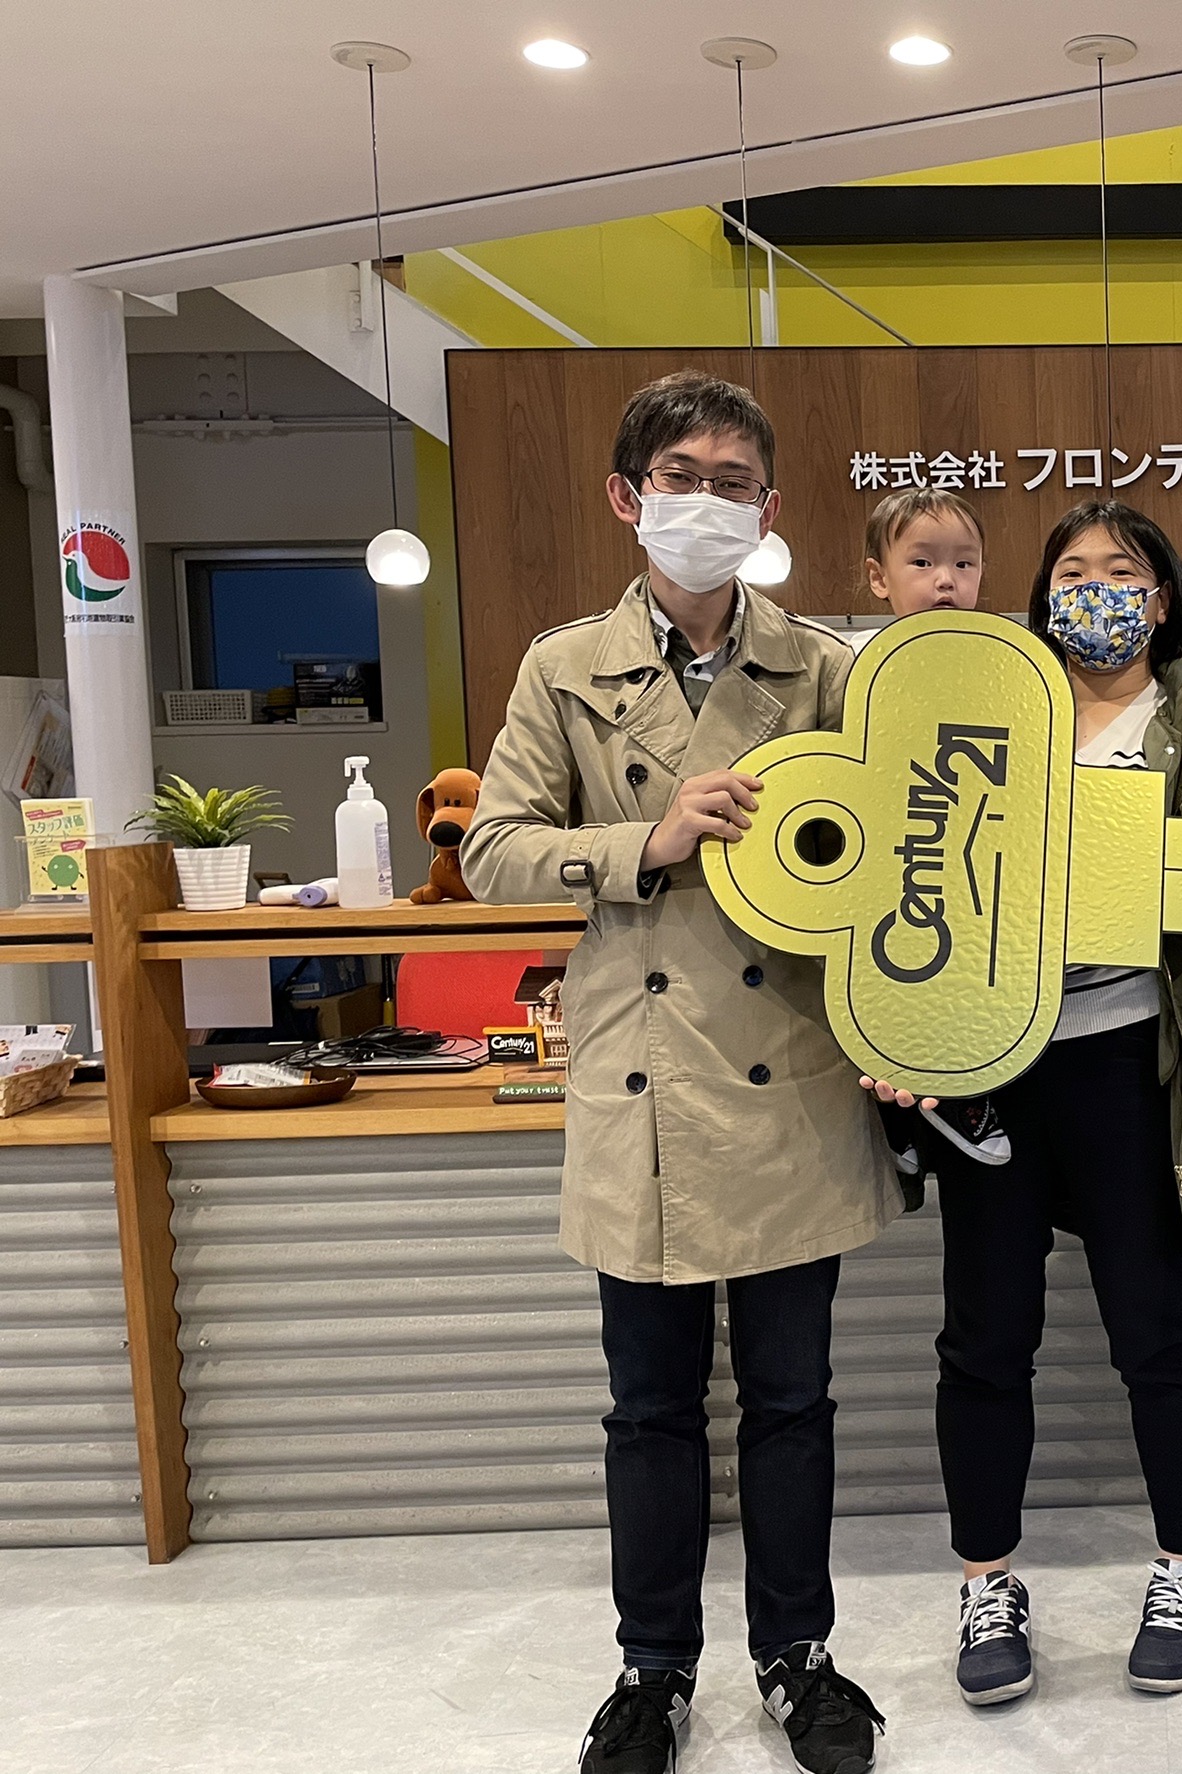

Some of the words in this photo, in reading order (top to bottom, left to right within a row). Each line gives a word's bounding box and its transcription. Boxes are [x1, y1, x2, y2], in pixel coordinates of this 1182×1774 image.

[849, 450, 1007, 490] 株式会社
[80, 522, 126, 545] PARTNER
[871, 758, 959, 984] Century
[934, 723, 1010, 787] 21
[491, 1036, 527, 1049] Century
[523, 1041, 535, 1054] 21
[515, 1087, 533, 1096] your
[537, 1086, 559, 1095] trust
